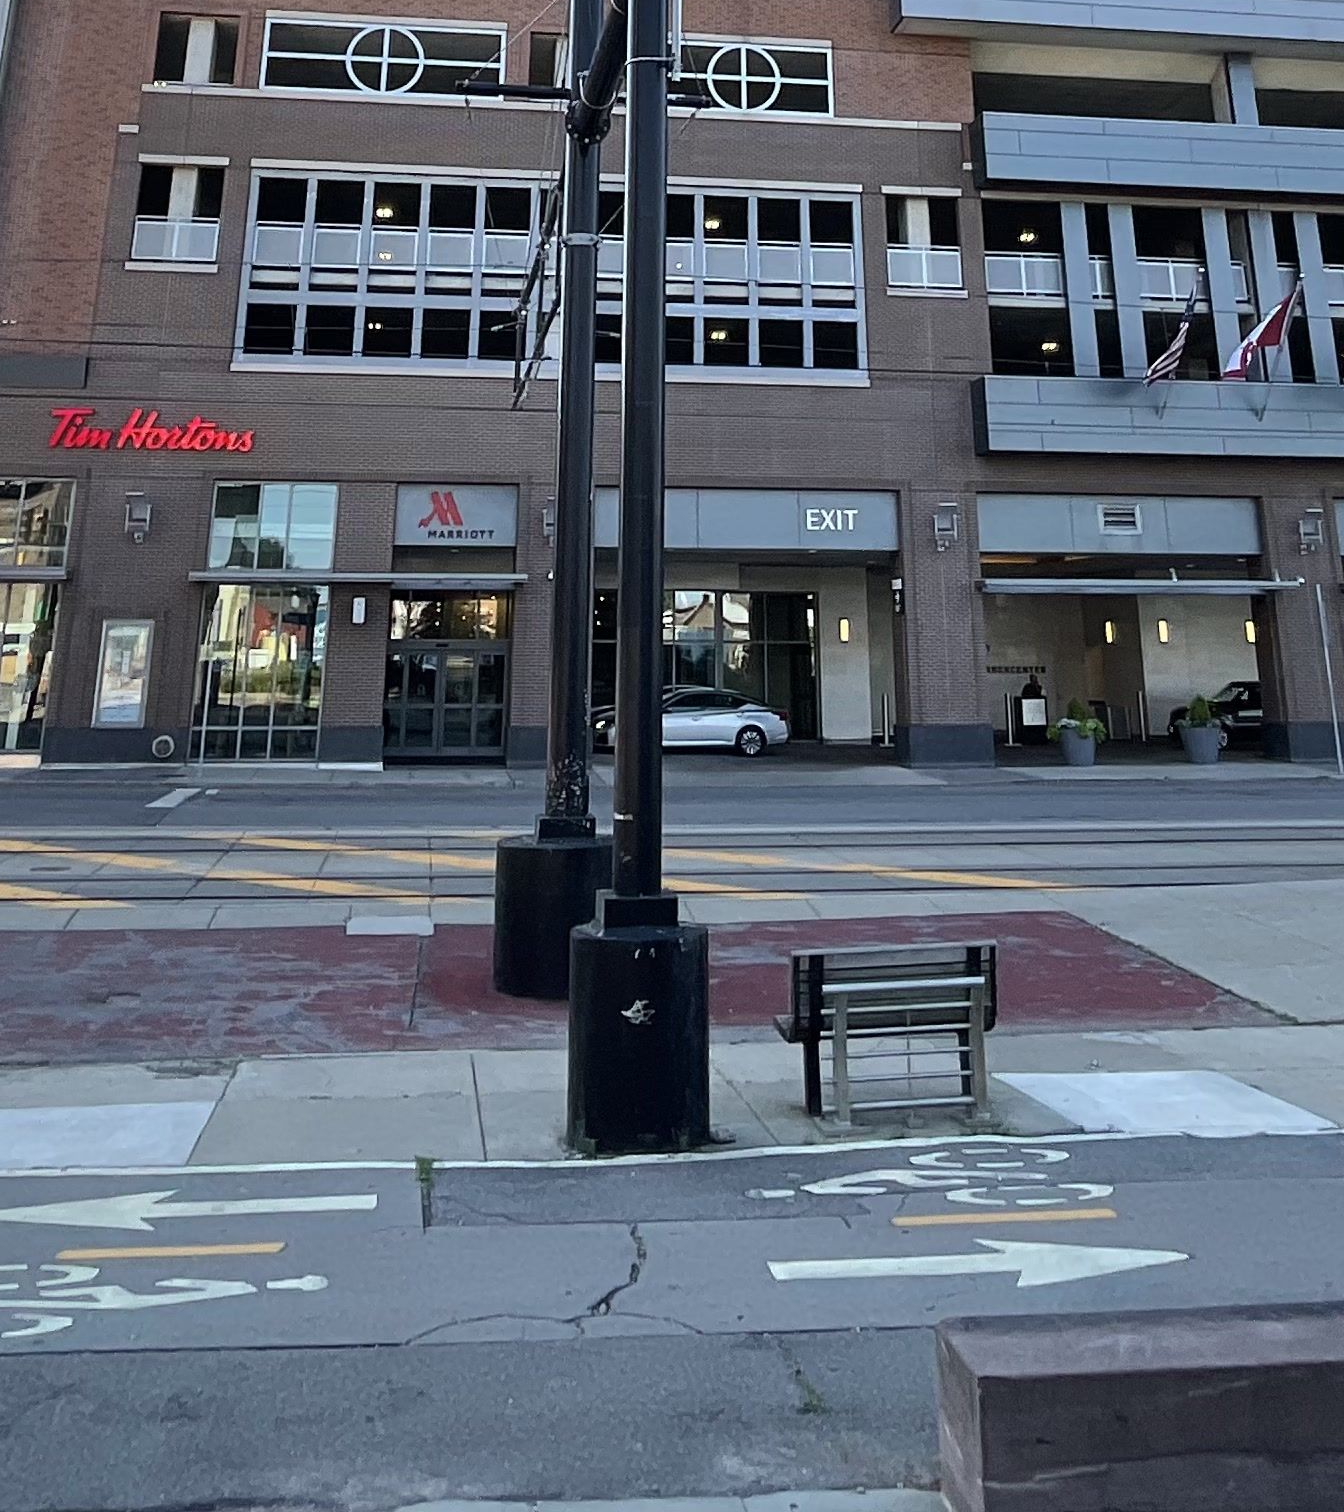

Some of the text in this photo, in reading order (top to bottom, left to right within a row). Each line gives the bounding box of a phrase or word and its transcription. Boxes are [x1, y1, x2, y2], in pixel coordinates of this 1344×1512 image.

[50, 408, 255, 452] Tim Hortons
[806, 508, 858, 531] EXIT
[427, 530, 494, 539] MARRIOTT
